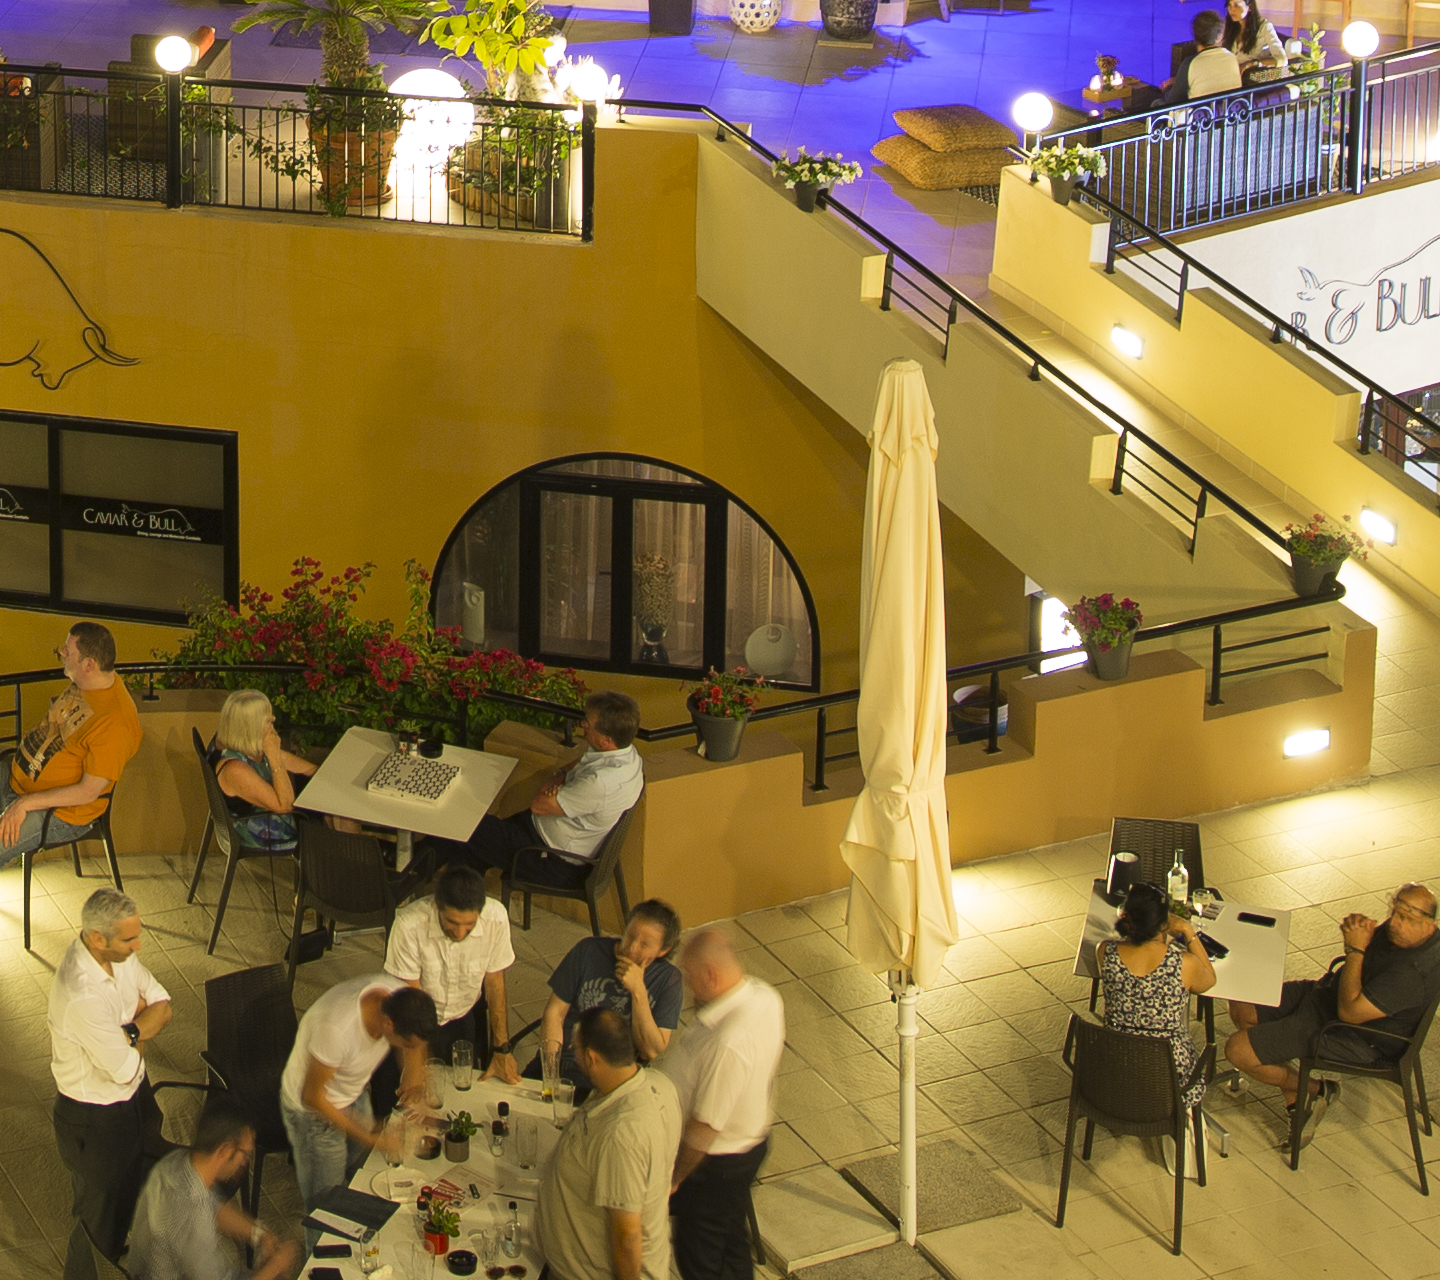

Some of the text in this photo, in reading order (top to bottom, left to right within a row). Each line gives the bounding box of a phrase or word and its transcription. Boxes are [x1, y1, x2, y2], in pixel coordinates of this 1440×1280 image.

[1324, 288, 1366, 345] &
[83, 507, 179, 532] CAVIAR & BULL
